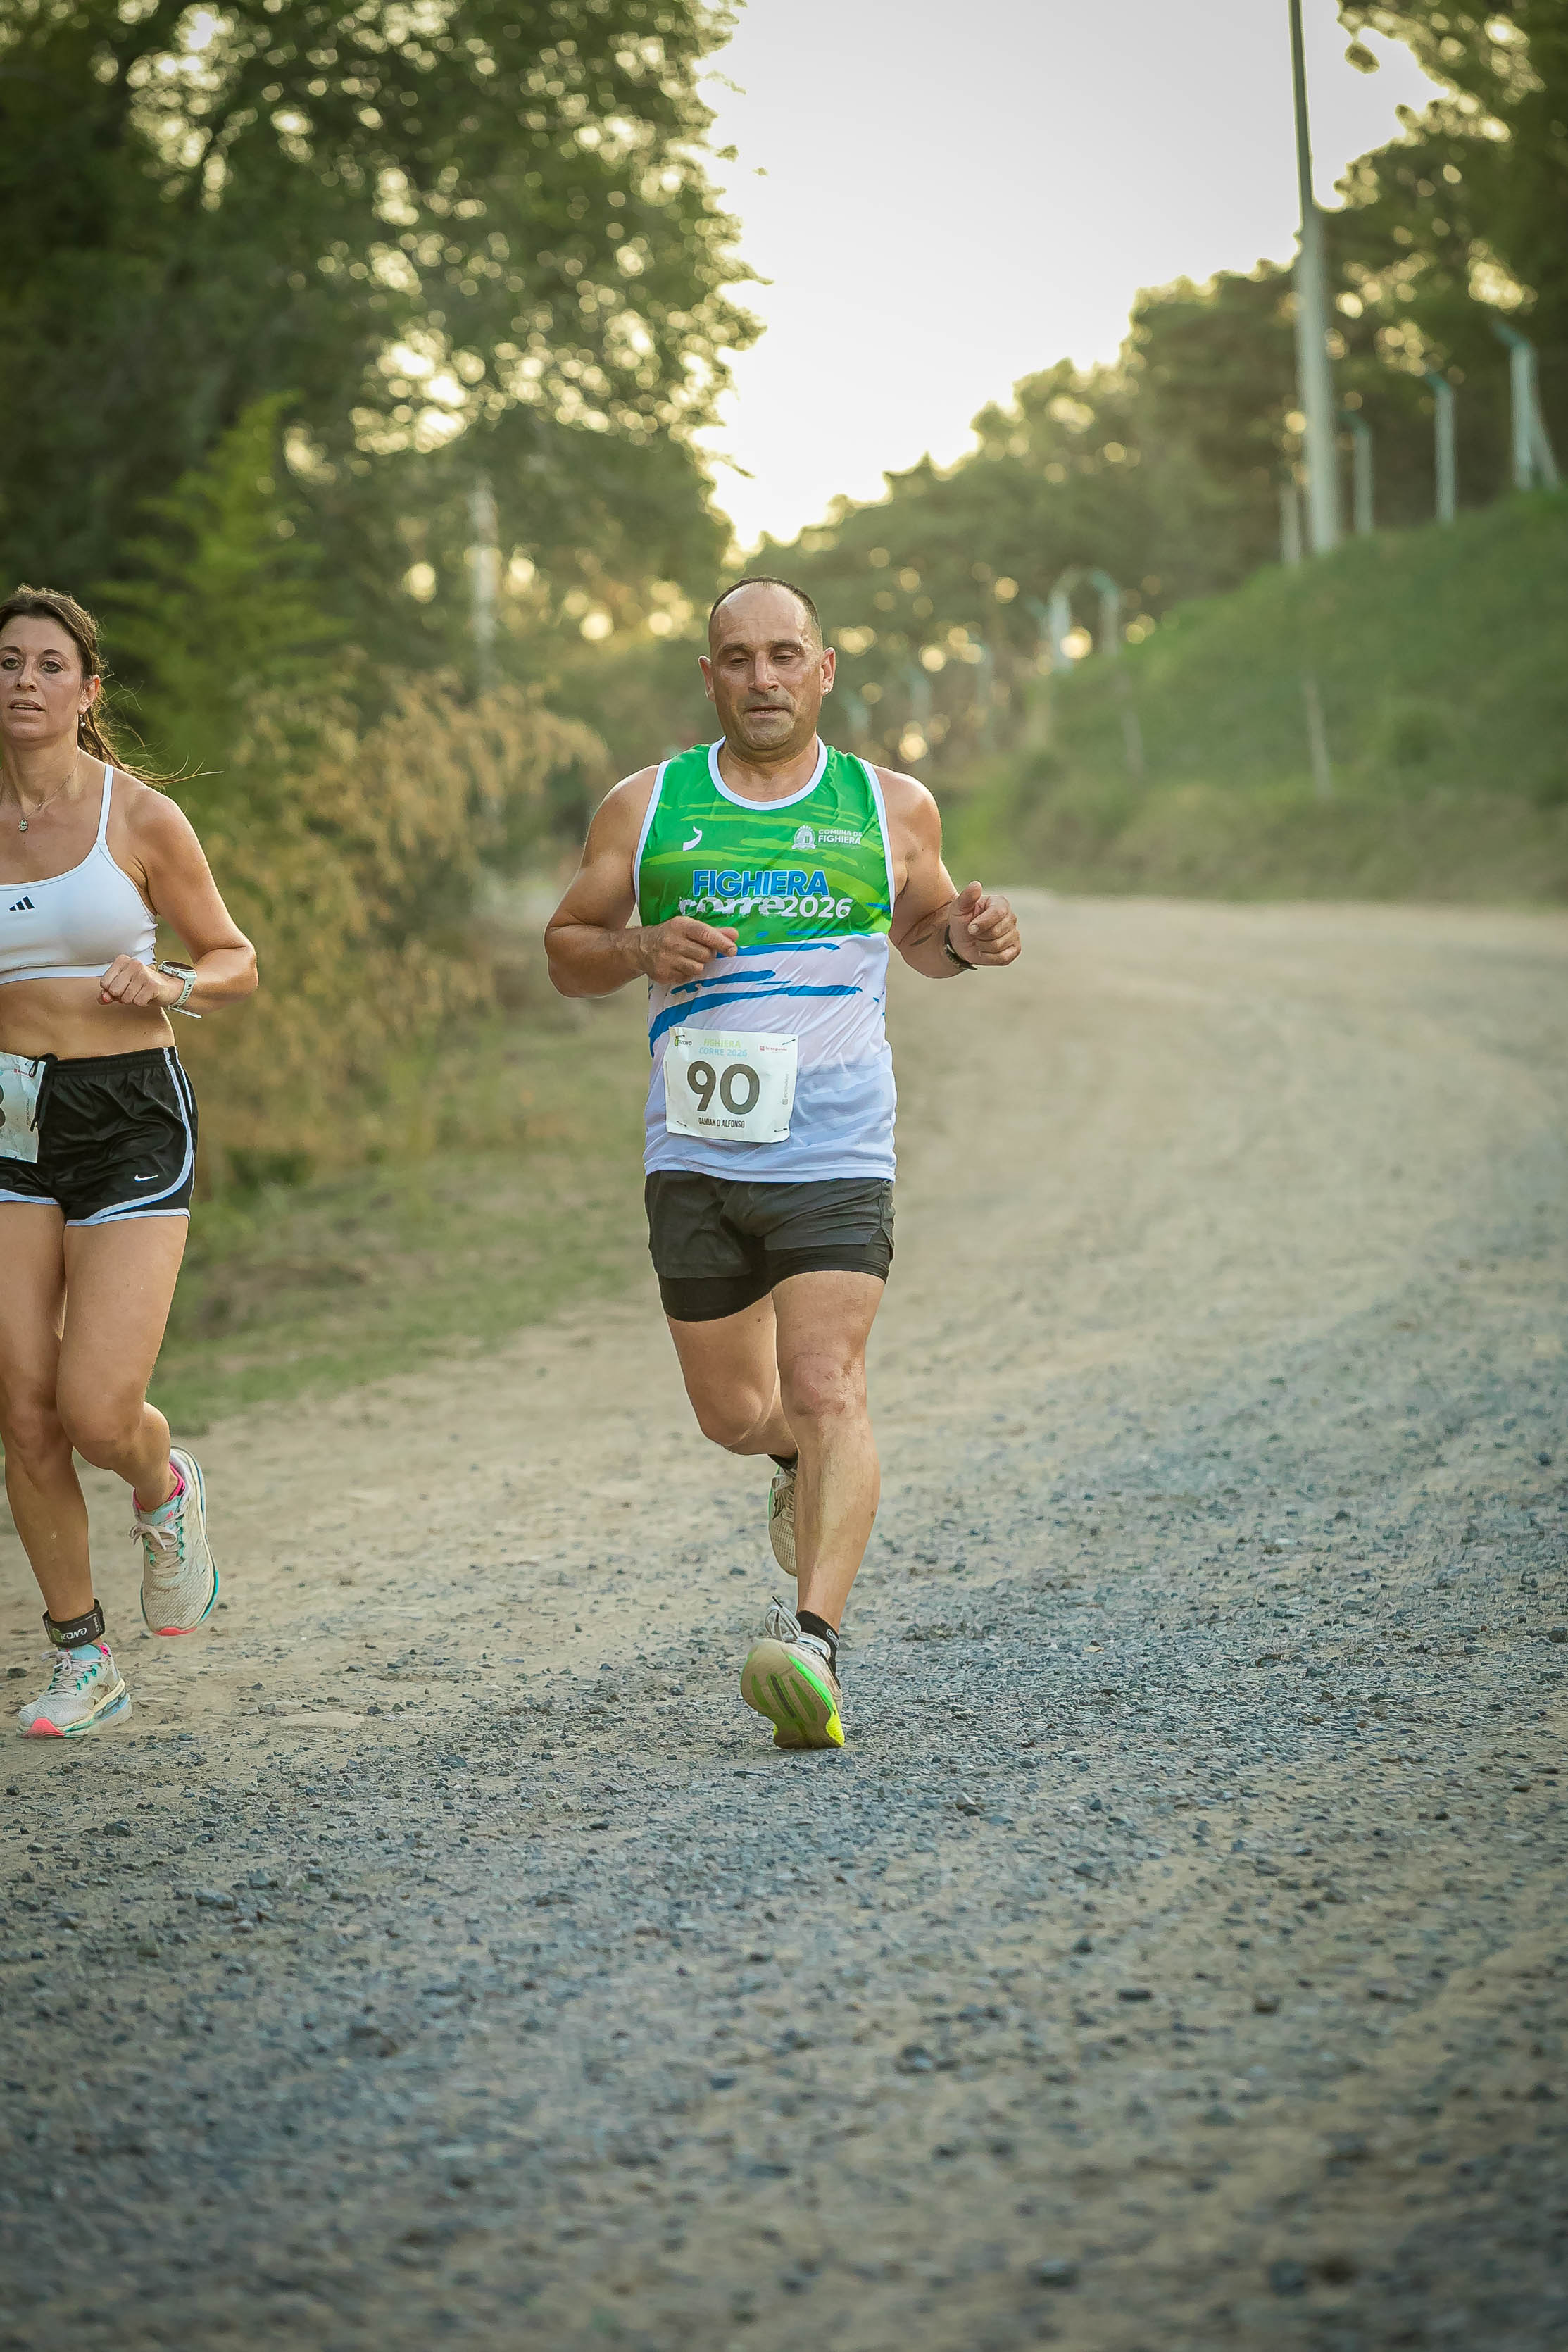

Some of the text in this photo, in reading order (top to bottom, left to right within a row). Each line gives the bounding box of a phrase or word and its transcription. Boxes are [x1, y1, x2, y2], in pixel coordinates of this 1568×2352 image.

[818, 834, 860, 844] FIGHIERA
[693, 870, 830, 897] FIGHIERA
[704, 1039, 741, 1048] FIGHIERA
[698, 1046, 748, 1057] CORRE 2026
[686, 1061, 760, 1115] 90
[722, 1120, 745, 1128] ALFONSO
